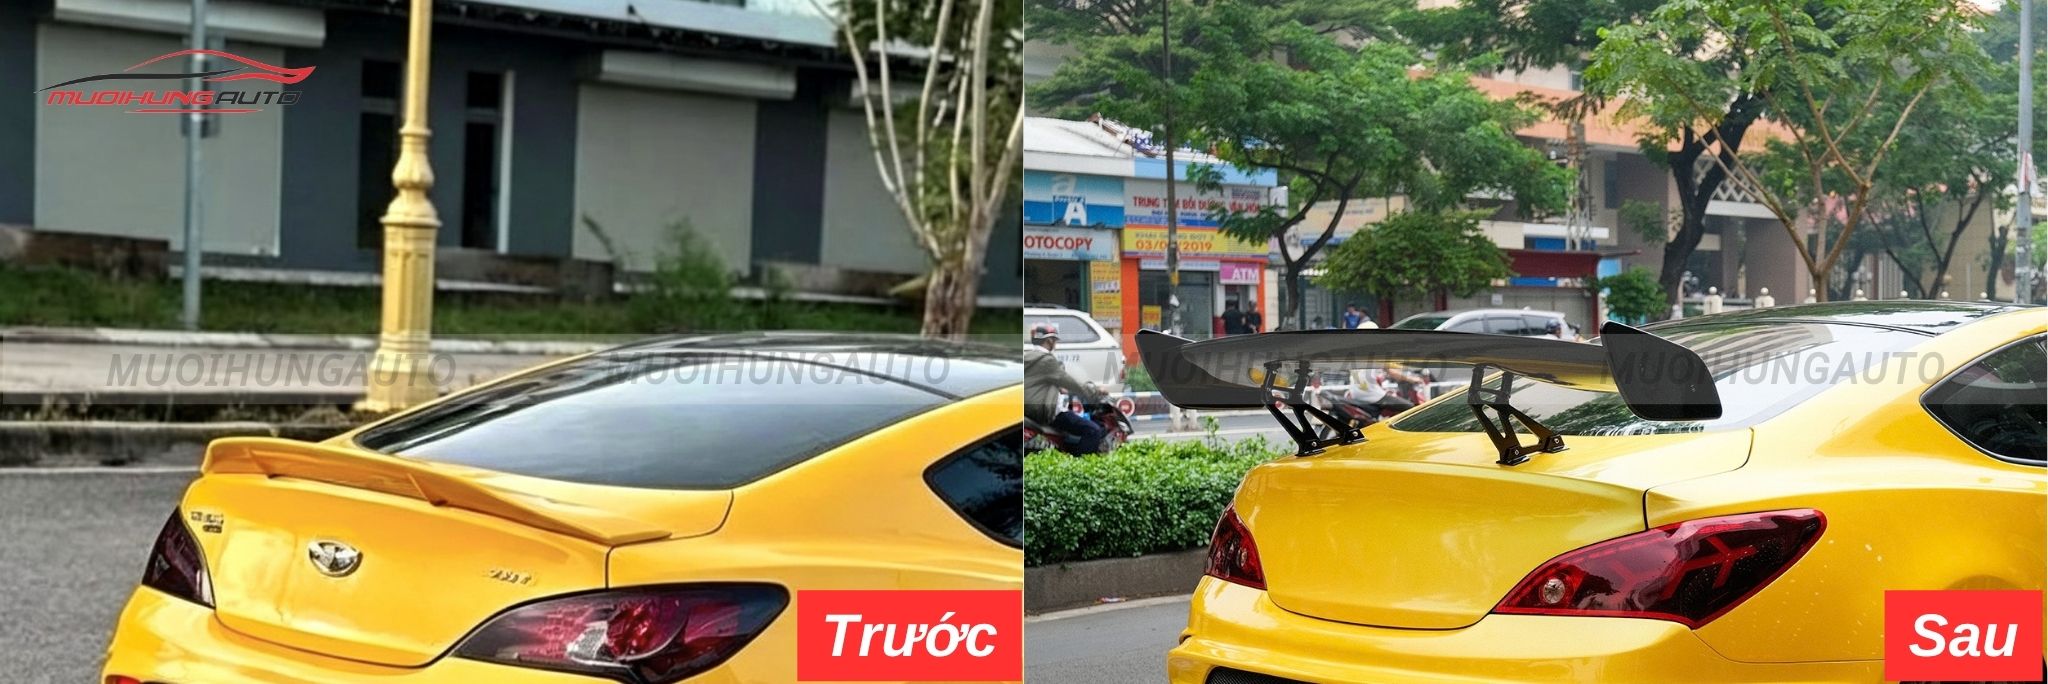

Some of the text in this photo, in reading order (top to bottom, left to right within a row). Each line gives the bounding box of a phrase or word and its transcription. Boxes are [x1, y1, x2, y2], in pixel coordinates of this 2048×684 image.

[1133, 196, 1160, 208] TRUNG
[1163, 198, 1180, 209] TM
[1024, 235, 1093, 251] OTOCOPY
[1136, 239, 1213, 253] 03/0/2019
[1232, 267, 1259, 281] ATM
